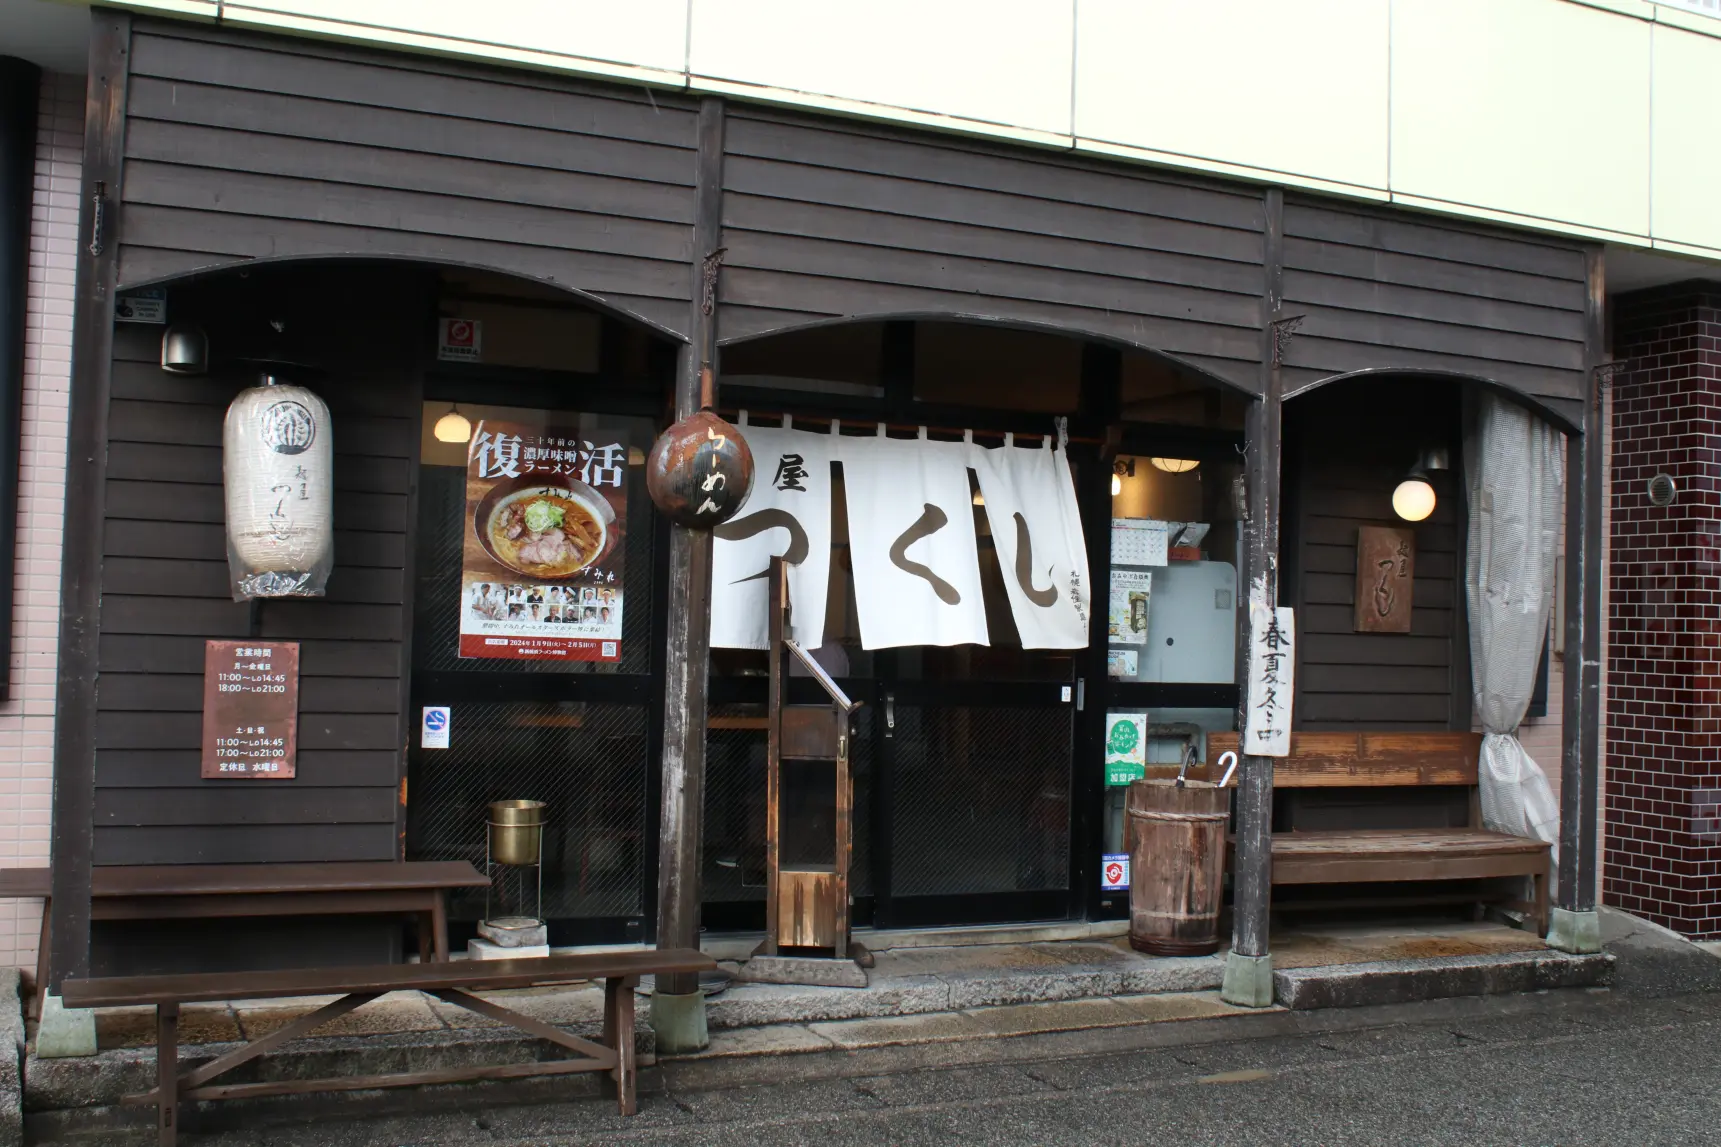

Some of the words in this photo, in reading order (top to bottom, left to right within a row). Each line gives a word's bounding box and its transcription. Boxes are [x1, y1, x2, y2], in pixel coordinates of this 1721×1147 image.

[525, 436, 576, 447] 三十年前の
[474, 432, 522, 479] 復
[579, 440, 625, 488] 活
[523, 446, 577, 463] 濃厚味噌
[524, 461, 577, 475] ラーメン
[695, 426, 726, 515] らーめん
[580, 565, 615, 583] すみれ
[235, 647, 272, 657] 営業時間
[1256, 616, 1291, 743] 春夏冬中
[219, 763, 246, 772] 定休日
[252, 763, 279, 773] 水曜日
[1110, 773, 1137, 782] 加盟店
